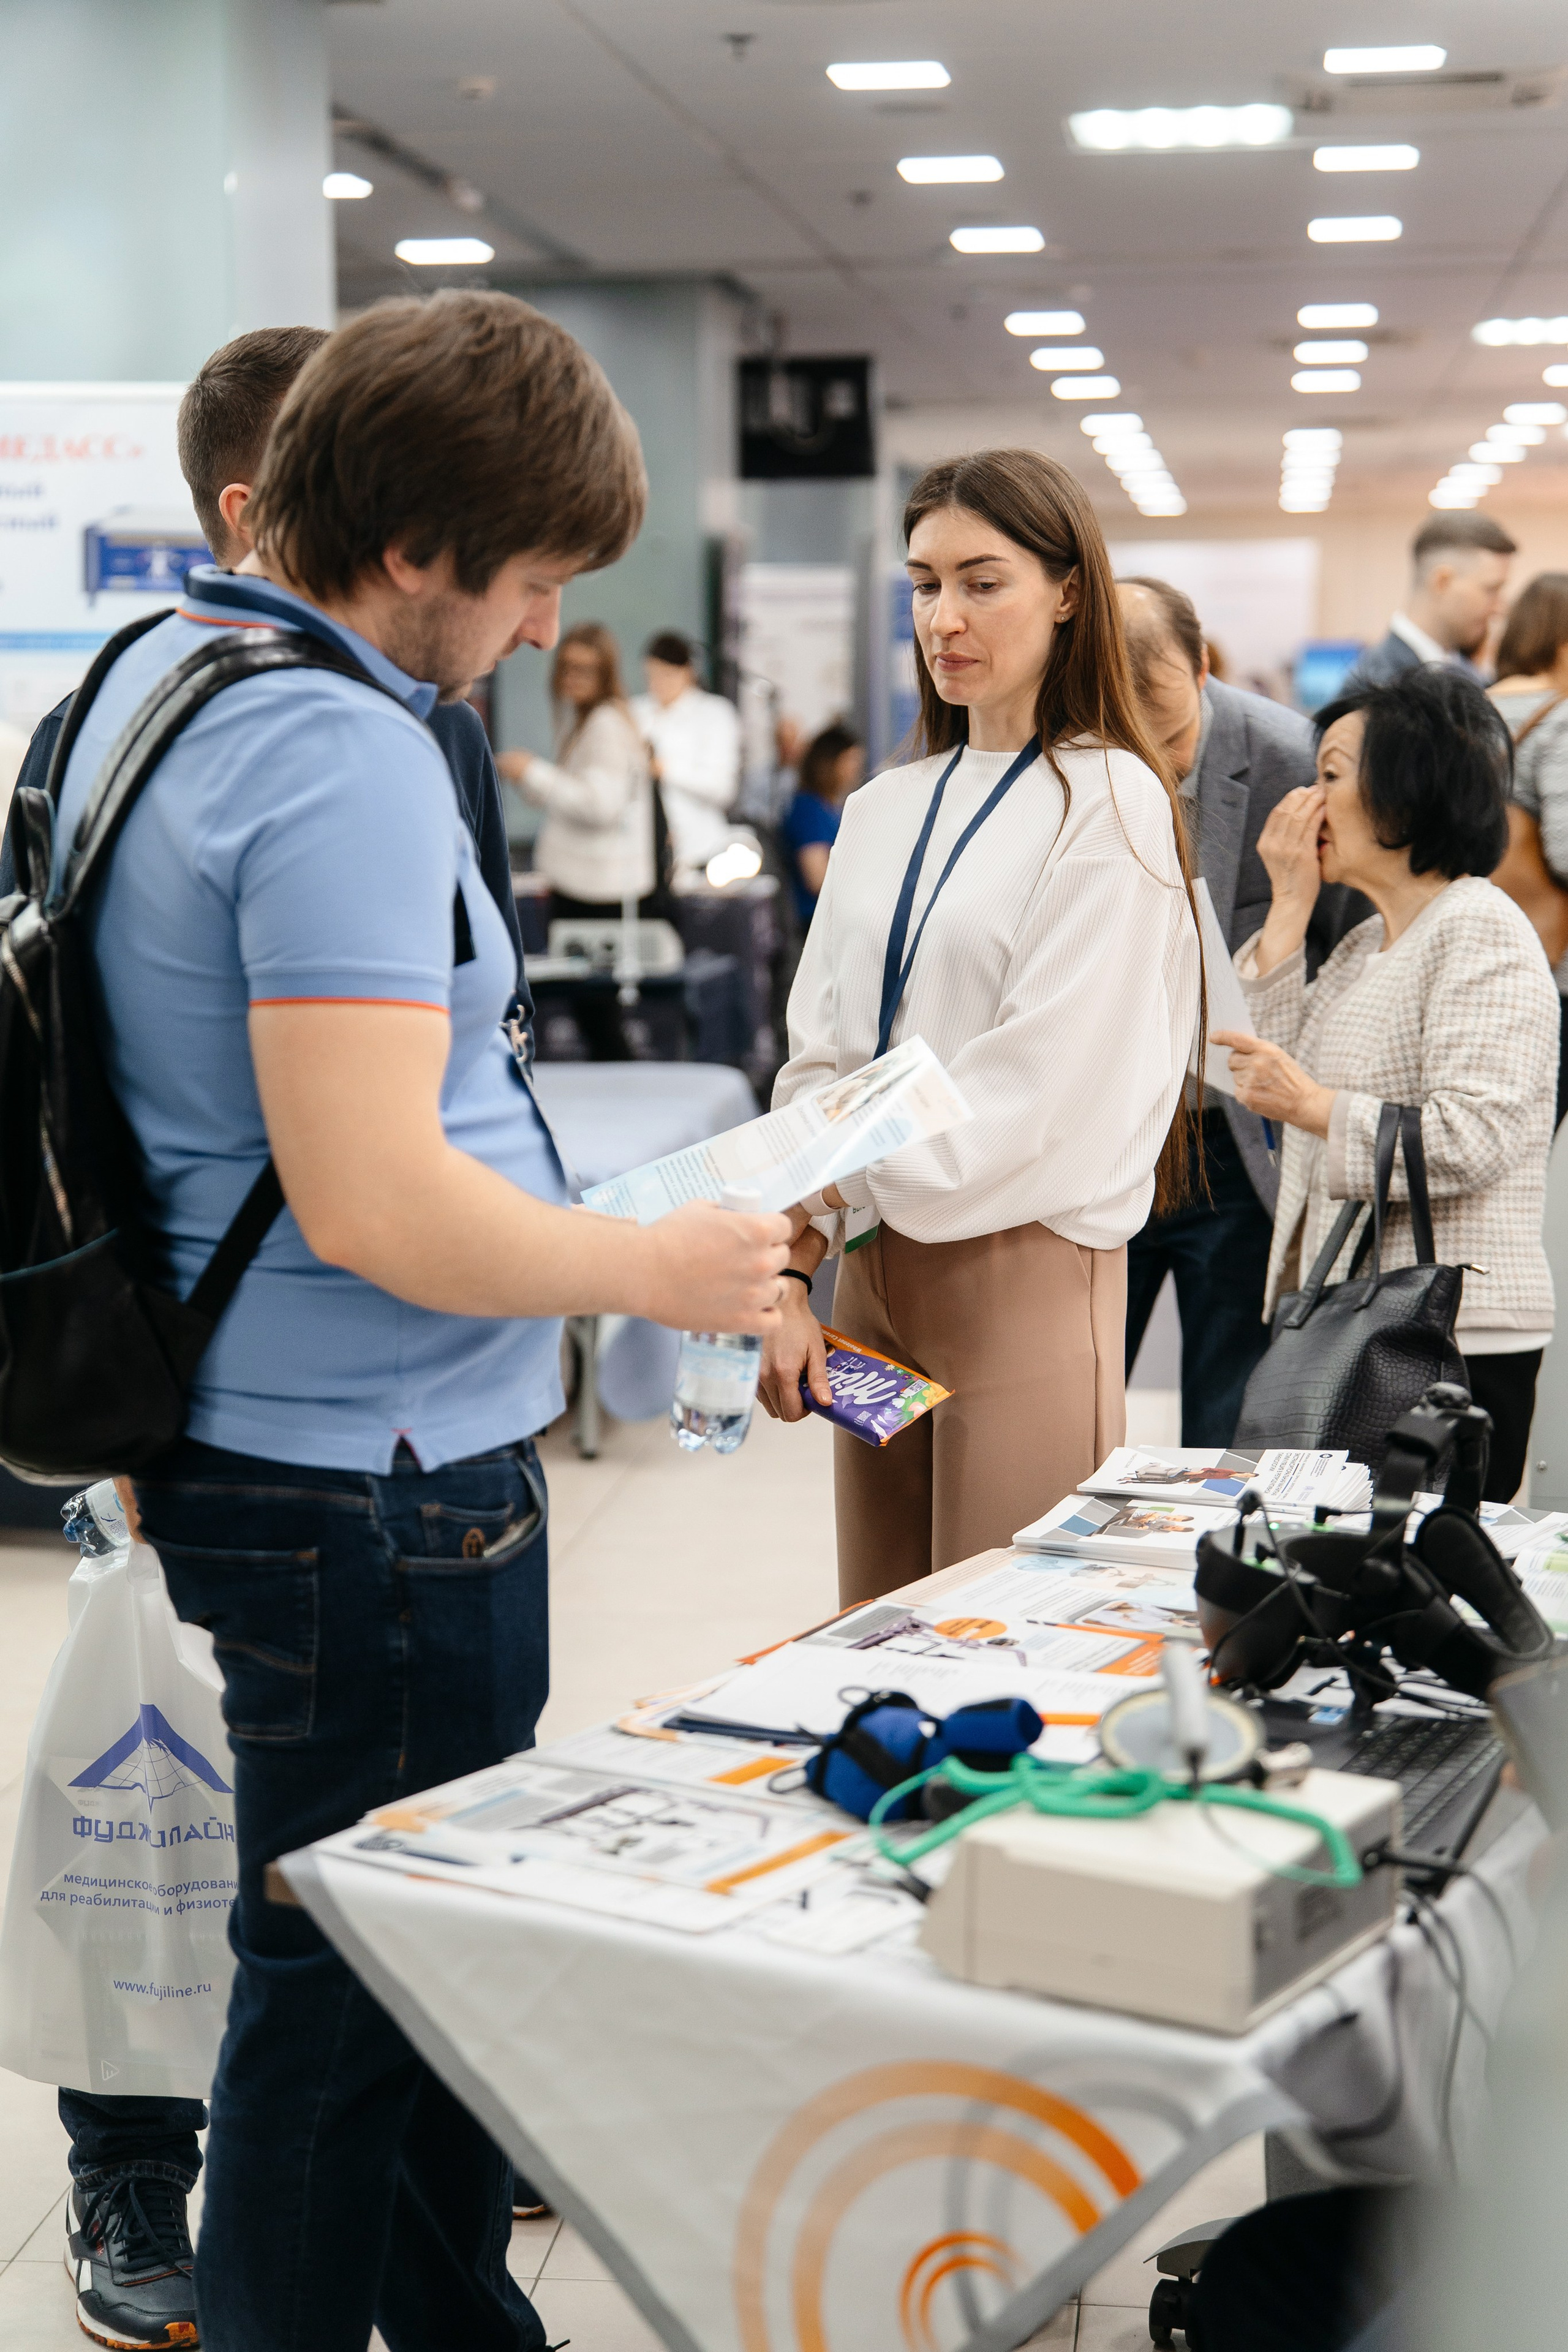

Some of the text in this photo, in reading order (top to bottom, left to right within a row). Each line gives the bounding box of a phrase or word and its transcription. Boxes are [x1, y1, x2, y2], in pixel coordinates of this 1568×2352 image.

[821, 1329, 838, 1340] Caram
[72, 1815, 235, 1848] ФУДЖИЛАЙН
[64, 1874, 239, 1897] медицинское оборудовани
[40, 1891, 236, 1915] для реабилитации и физиоте
[113, 1980, 211, 2000] www.fujiline.ru
